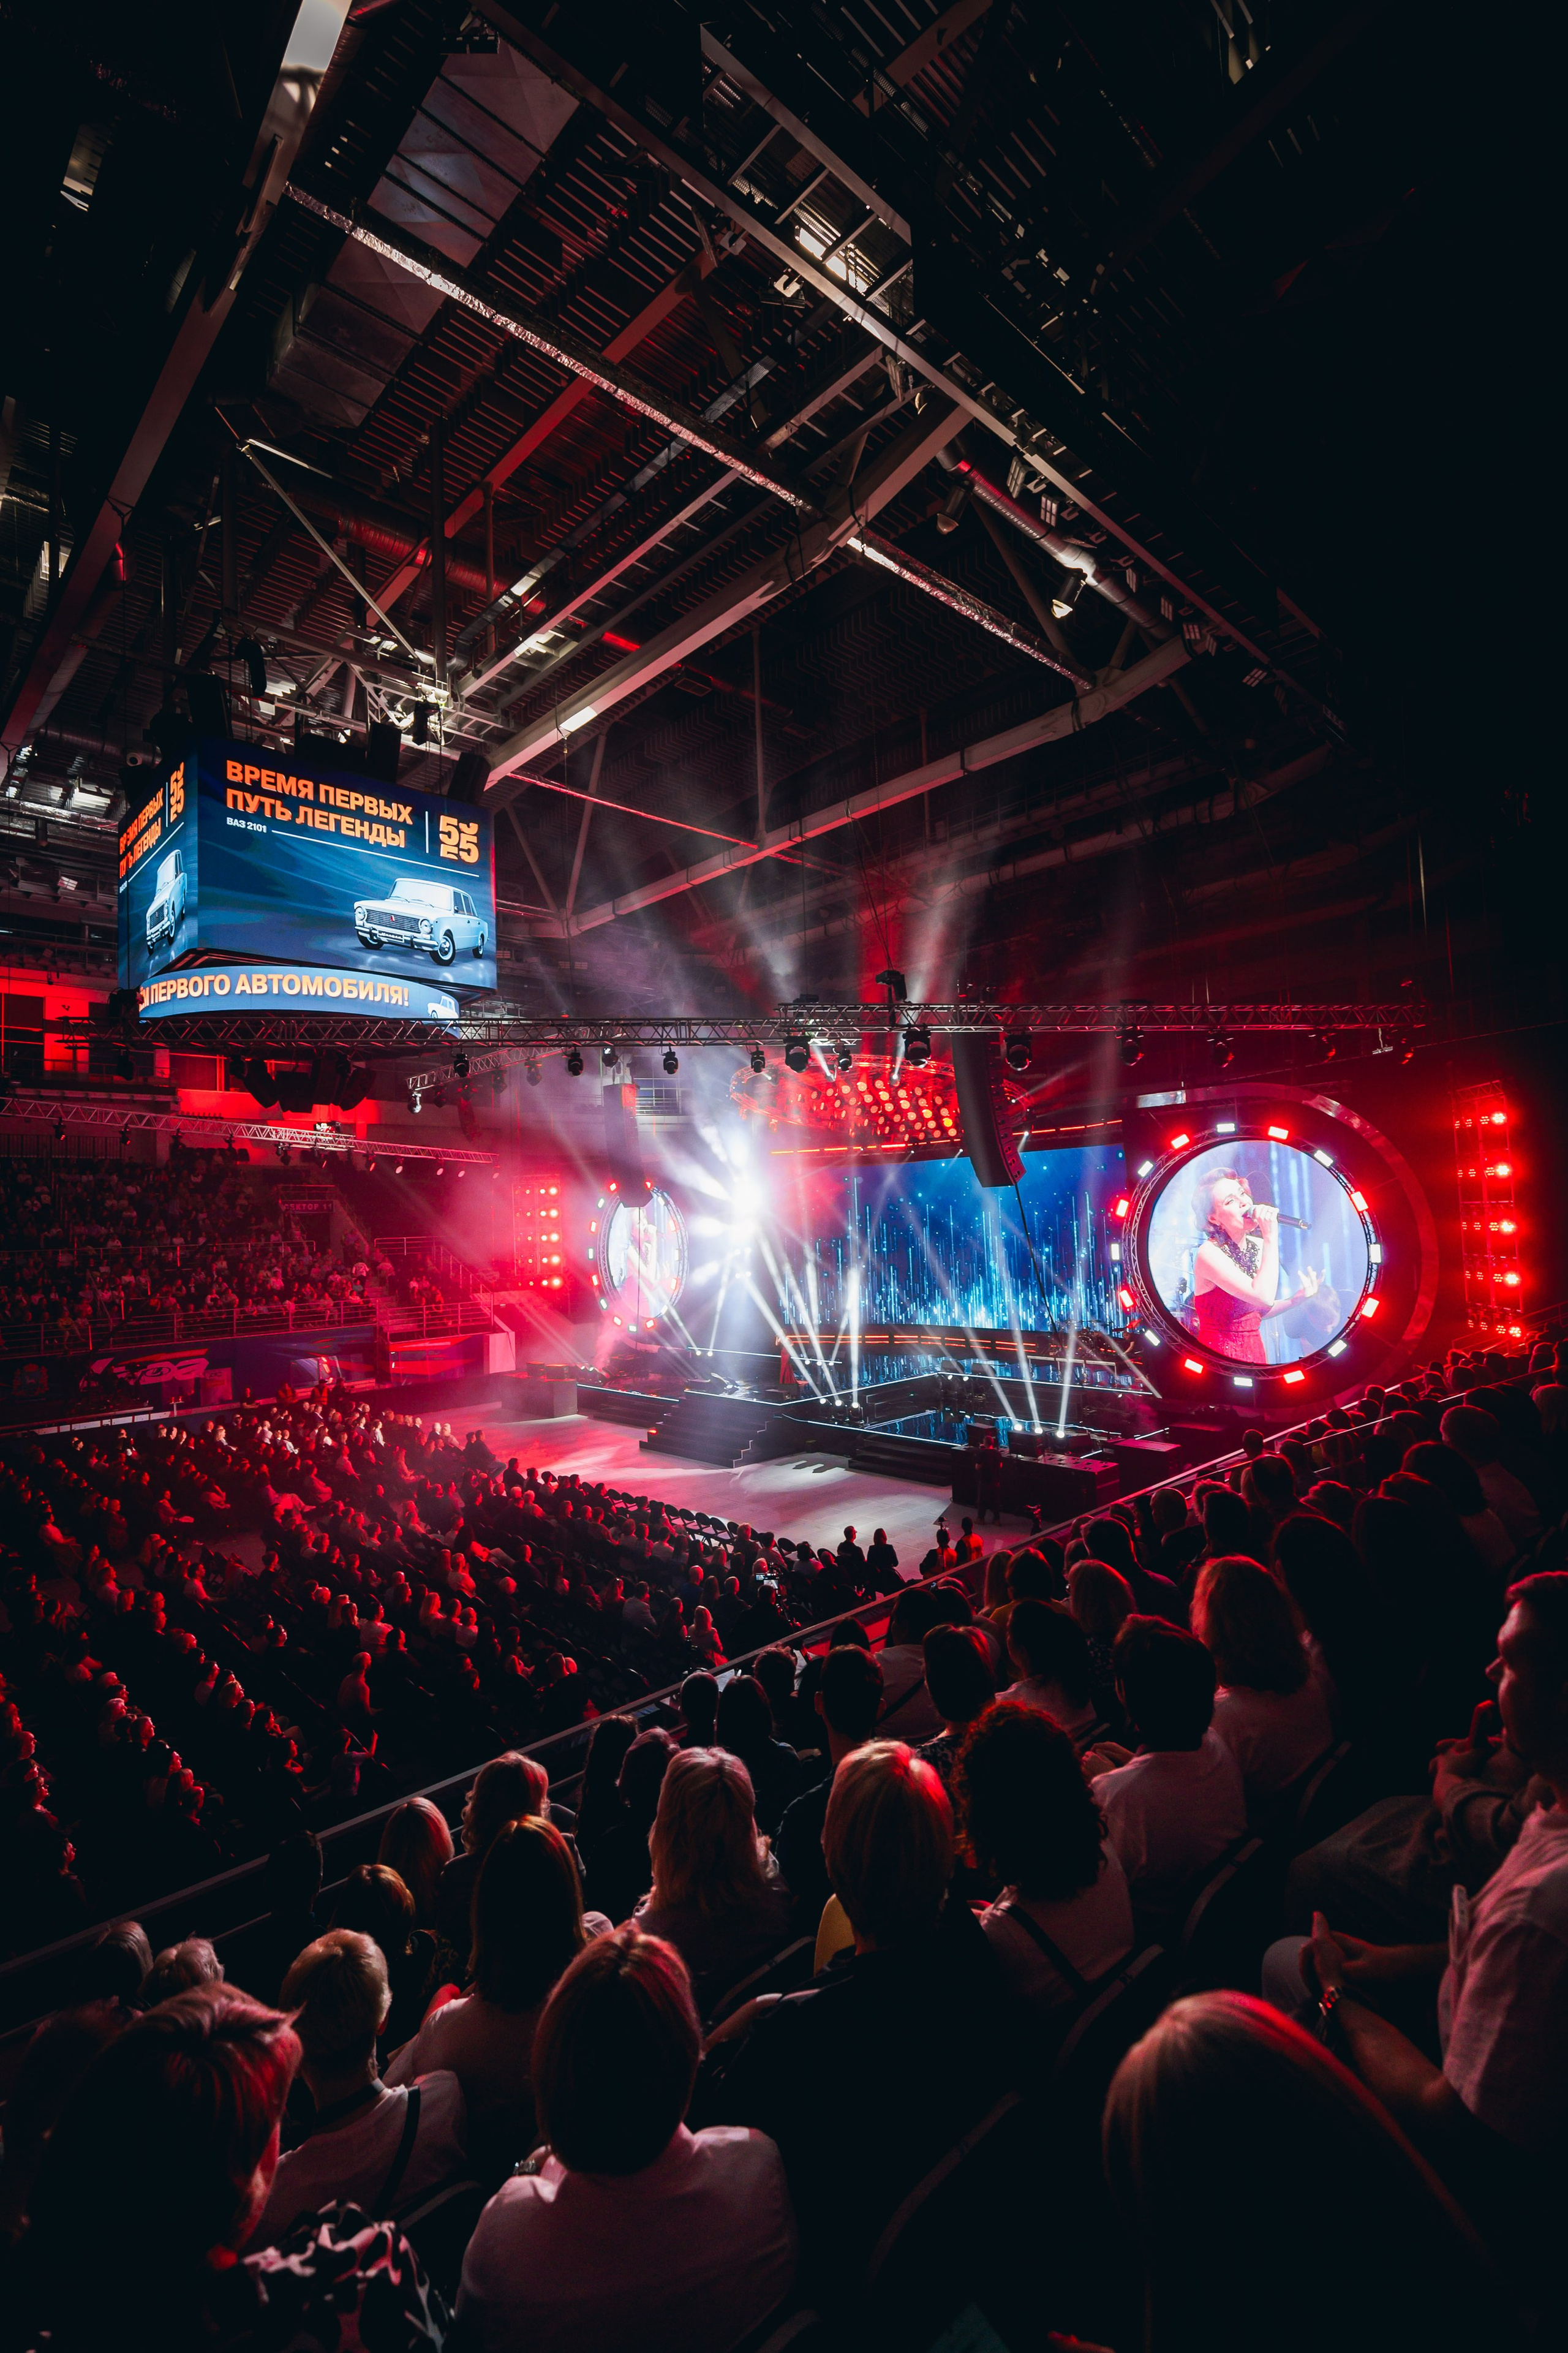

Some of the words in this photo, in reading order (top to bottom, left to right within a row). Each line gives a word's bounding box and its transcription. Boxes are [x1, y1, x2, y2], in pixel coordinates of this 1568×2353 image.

[138, 788, 164, 833] ПЕРВЫХ
[227, 760, 314, 801] ВРЕМЯ
[319, 784, 413, 825] ПЕРВЫХ
[133, 817, 161, 864] ЛЕГЕНДЫ
[227, 788, 292, 821] ПУТЬ
[295, 805, 405, 848] ЛЕГЕНДЫ
[227, 817, 246, 828] ВАЗ
[247, 823, 267, 833] 2101
[151, 974, 231, 1004] ПЕРВОГО
[235, 973, 409, 1007] АВТОМОБИЛЯ!
